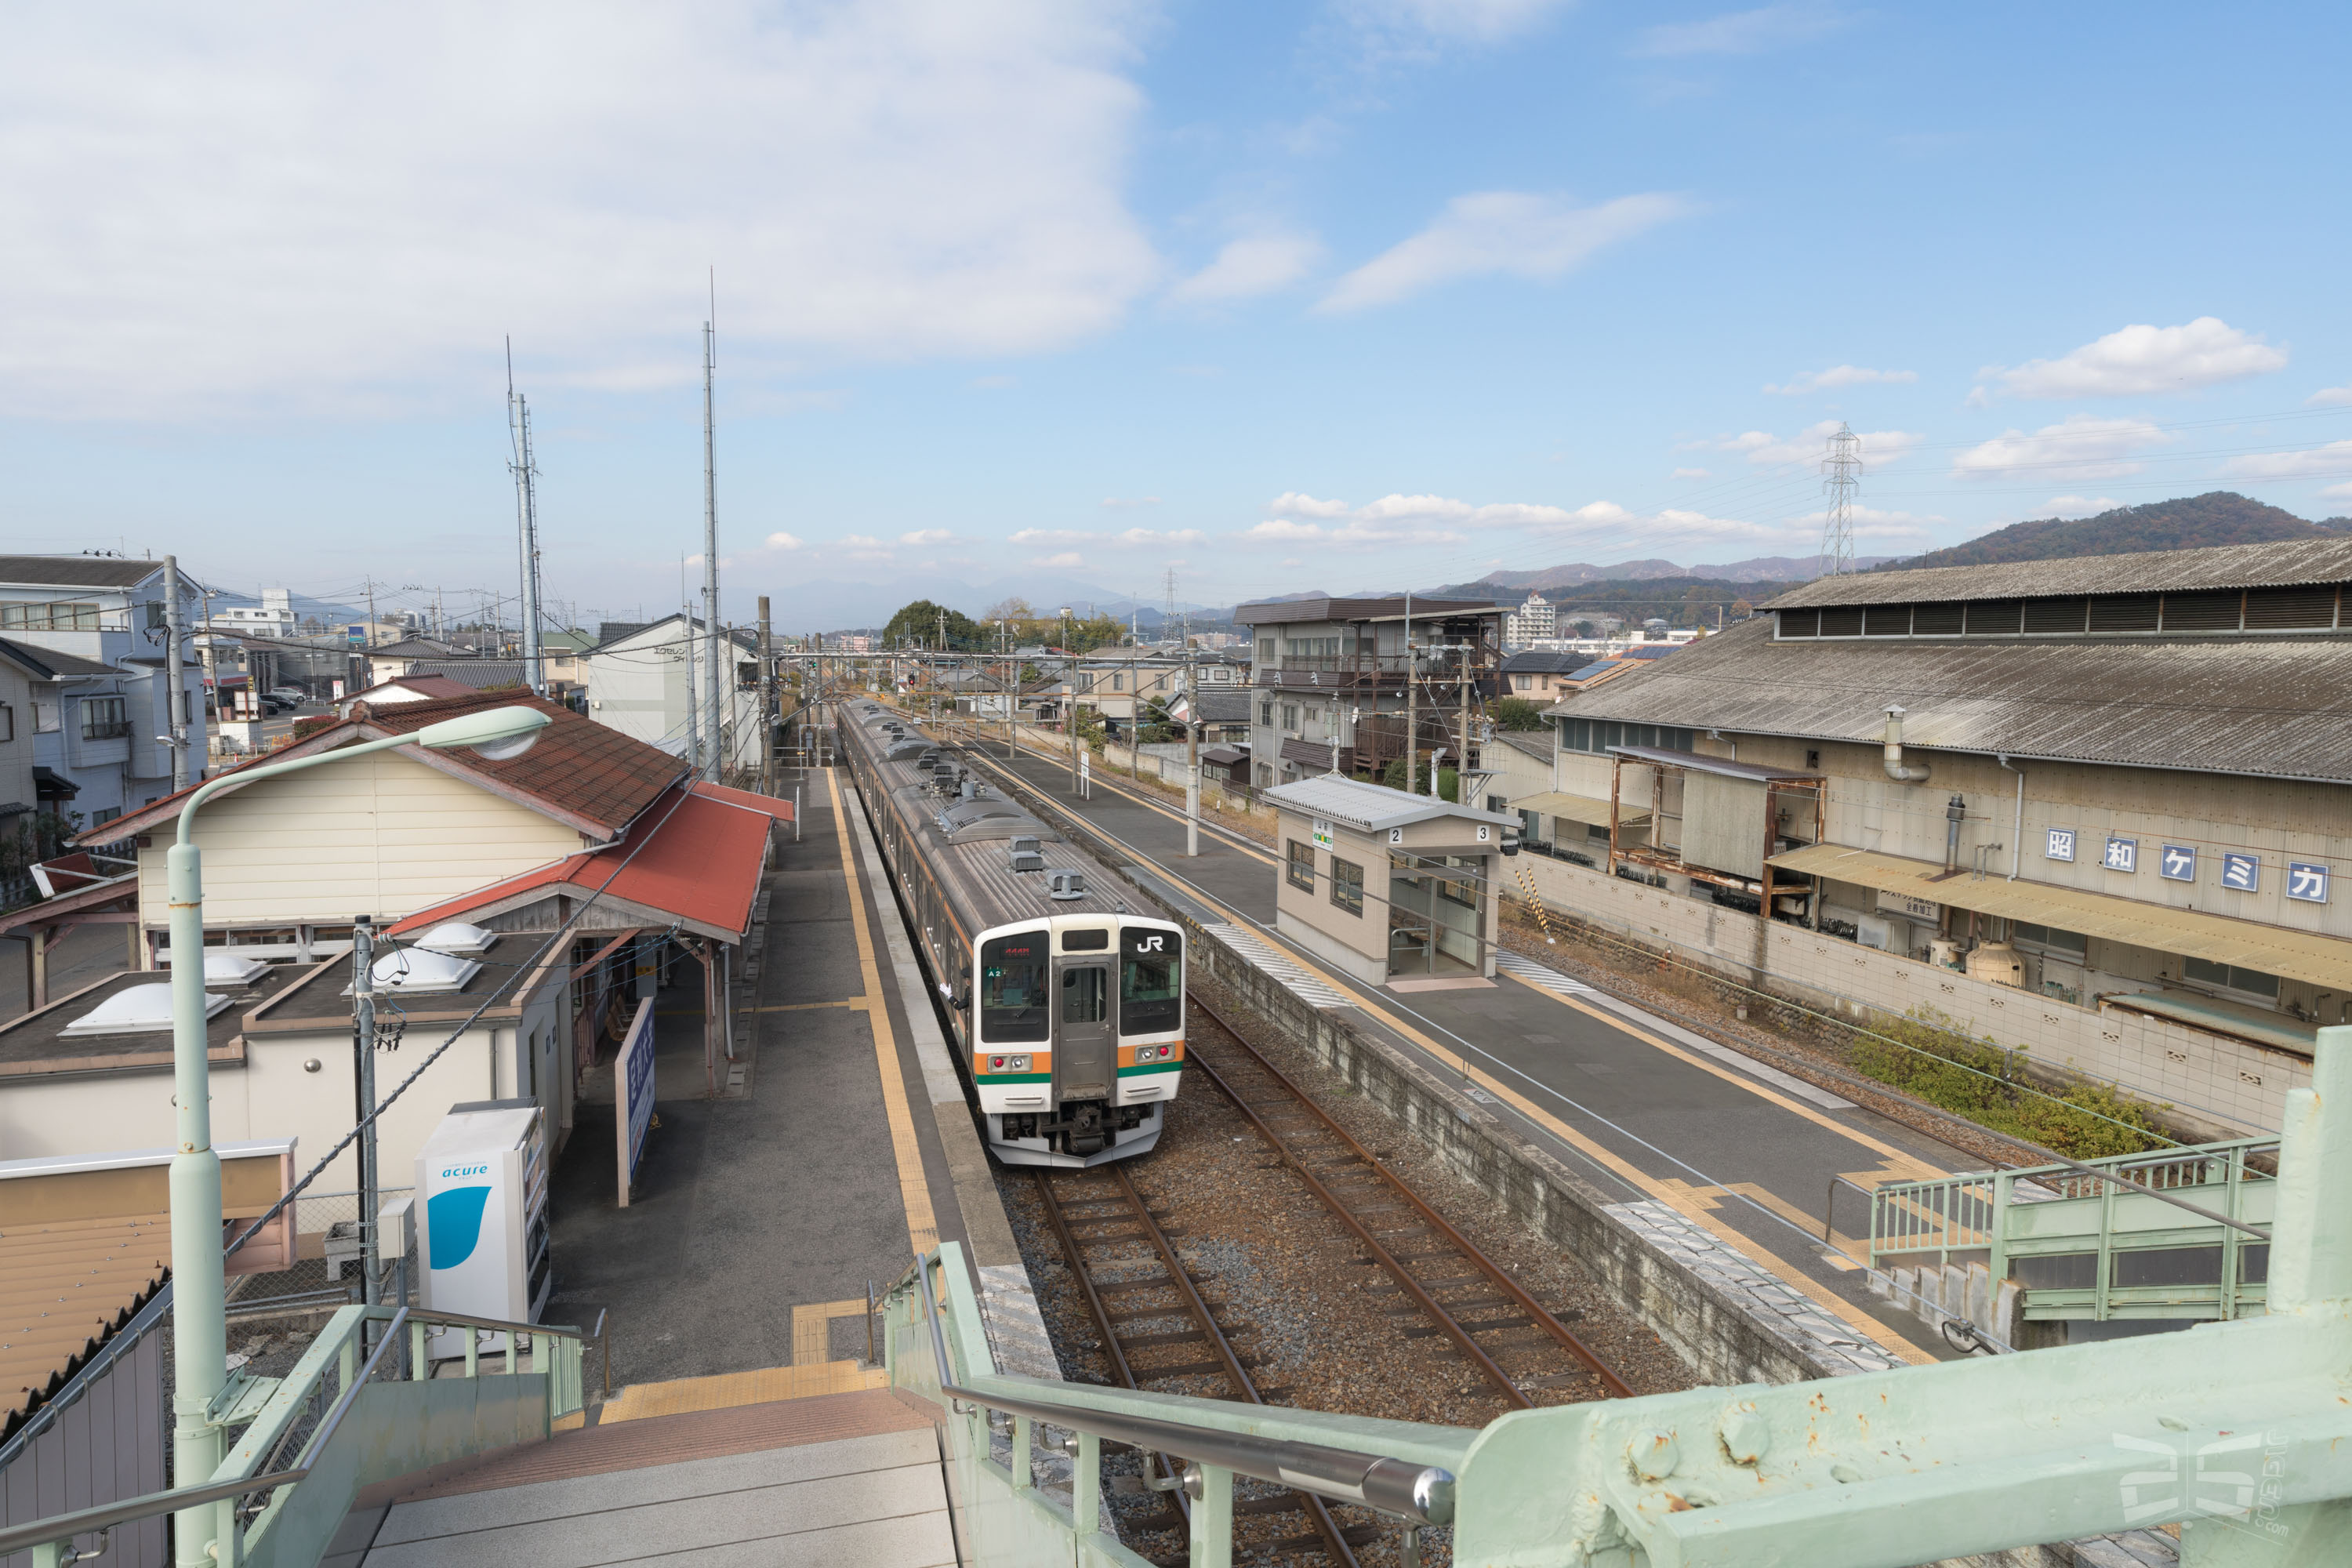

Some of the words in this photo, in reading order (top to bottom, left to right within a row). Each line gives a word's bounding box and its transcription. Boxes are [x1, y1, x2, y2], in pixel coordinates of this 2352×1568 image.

[1392, 829, 1399, 841] 2
[1480, 827, 1486, 840] 3
[1137, 936, 1163, 953] JR
[442, 1166, 488, 1178] acure
